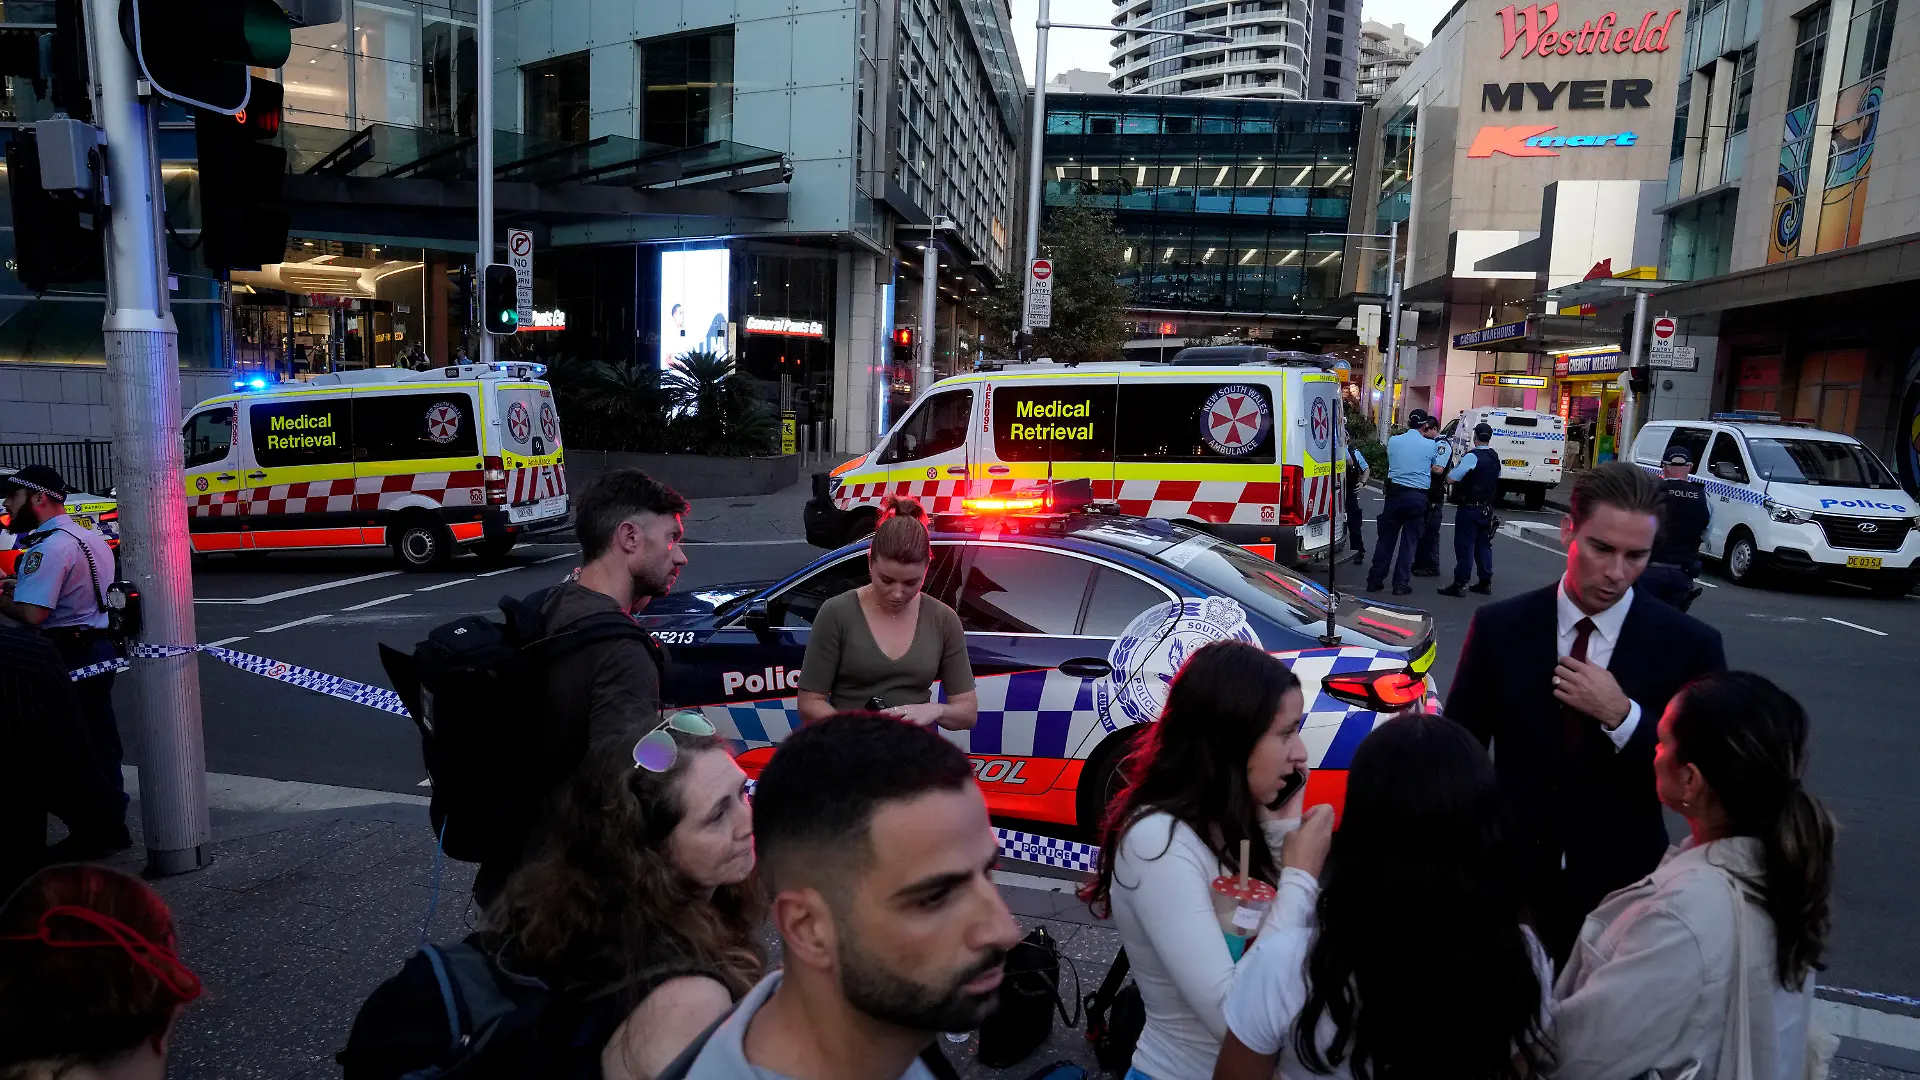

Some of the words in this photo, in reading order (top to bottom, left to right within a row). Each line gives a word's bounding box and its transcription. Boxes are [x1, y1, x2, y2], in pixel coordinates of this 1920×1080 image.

[1495, 2, 1681, 59] Westfield
[1482, 78, 1653, 112] MYER
[1467, 125, 1638, 158] Kmart
[514, 259, 527, 268] NO
[746, 316, 784, 332] General
[783, 319, 811, 334] Pants
[1459, 331, 1481, 346] CHEMIST
[1482, 324, 1516, 342] WAREHOUSE
[1568, 357, 1591, 372] CHEMIST
[1519, 378, 1544, 386] WAREHOUSE
[1016, 400, 1091, 418] Medical
[1203, 394, 1219, 413] NEW
[1218, 385, 1248, 397] SOUTH
[1248, 388, 1268, 415] WALES
[270, 412, 332, 431] Medical
[1010, 422, 1094, 440] Retrieval
[267, 431, 336, 450] Retrieval
[1208, 439, 1259, 456] AMBULANCE
[470, 493, 483, 501] 000
[1669, 489, 1699, 499] POLICE
[1819, 498, 1907, 513] Police
[1260, 511, 1275, 519] 000
[1859, 558, 1869, 567] 03
[1152, 624, 1178, 642] NEW
[1187, 621, 1223, 640] SOUTH
[722, 665, 801, 696] Polic
[366, 692, 399, 706] POLICE
[1133, 677, 1158, 714] POLICE
[1022, 843, 1071, 860] POLICE
